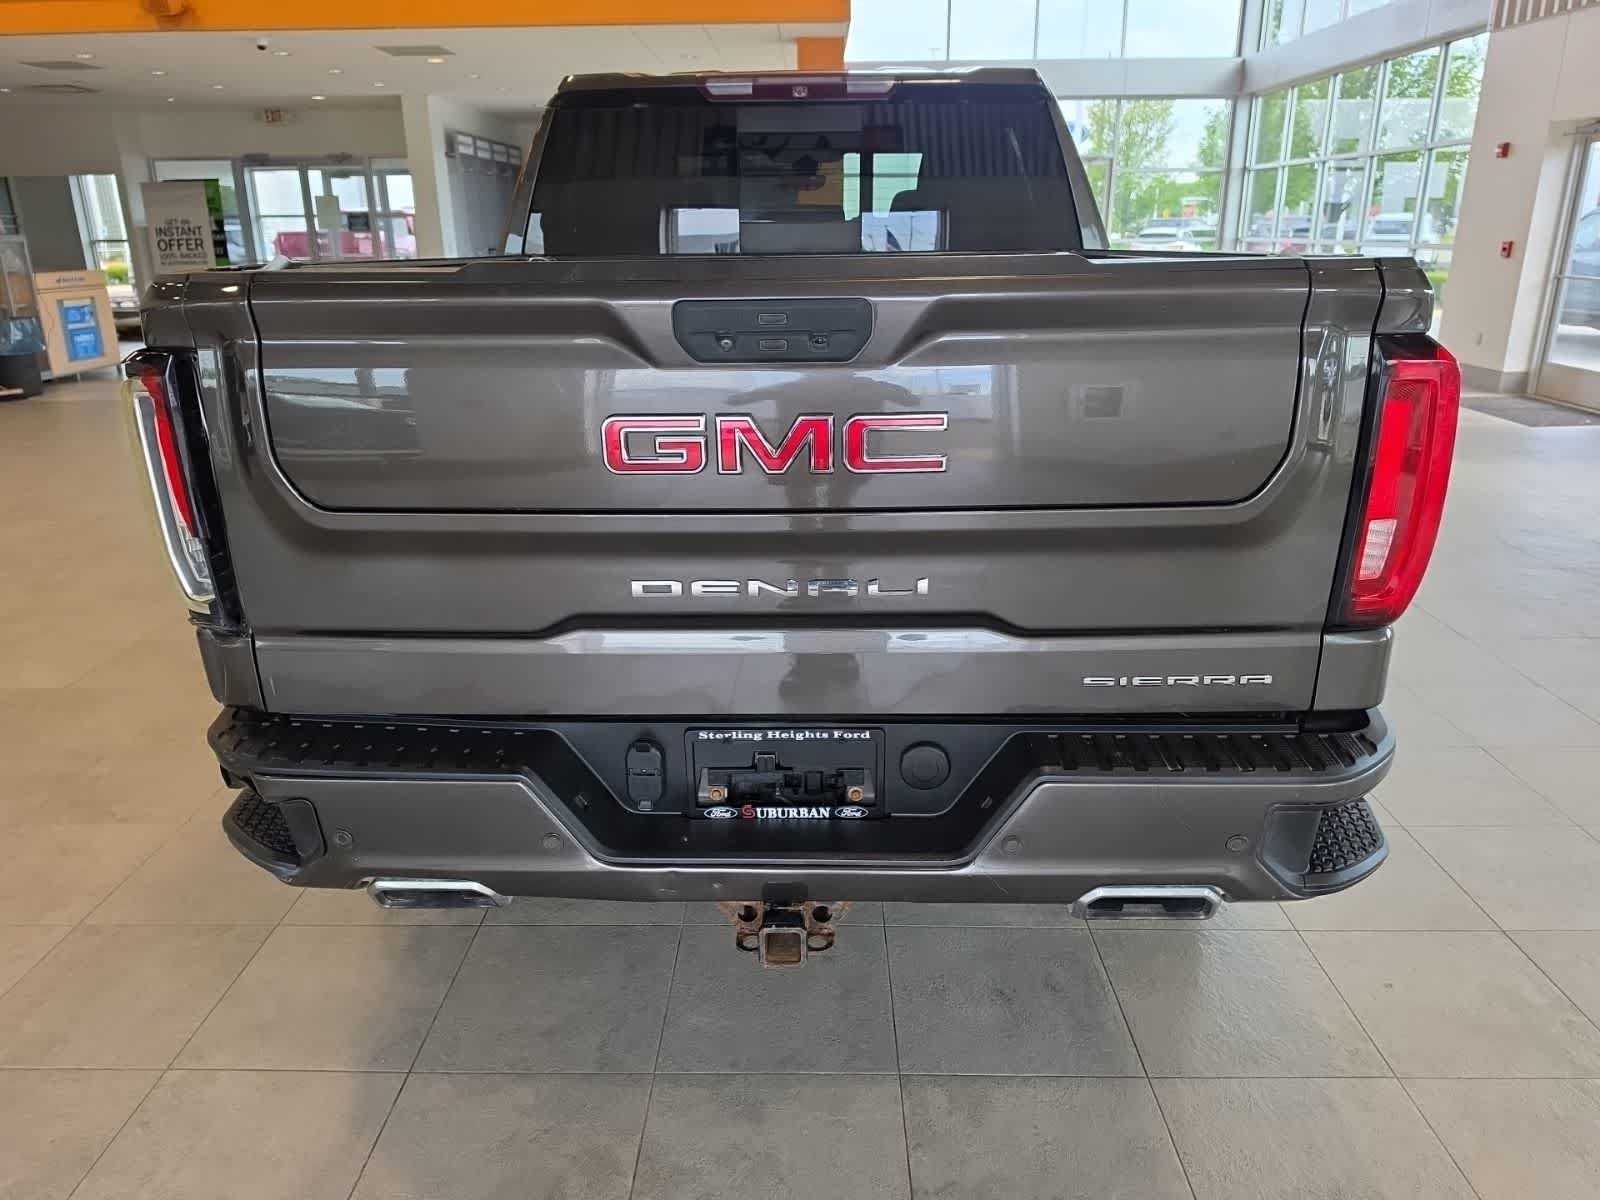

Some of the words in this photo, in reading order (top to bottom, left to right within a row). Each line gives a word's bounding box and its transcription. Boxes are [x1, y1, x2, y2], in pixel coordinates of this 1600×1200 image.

[155, 226, 202, 237] INSTANT
[157, 238, 204, 251] OFFER
[602, 412, 948, 474] GMC
[631, 578, 928, 597] DENALI
[1083, 675, 1273, 687] SIERRA
[698, 731, 762, 740] Sterling
[767, 731, 828, 740] Heights
[833, 731, 870, 739] Ford
[742, 805, 830, 818] SUBURBAN
